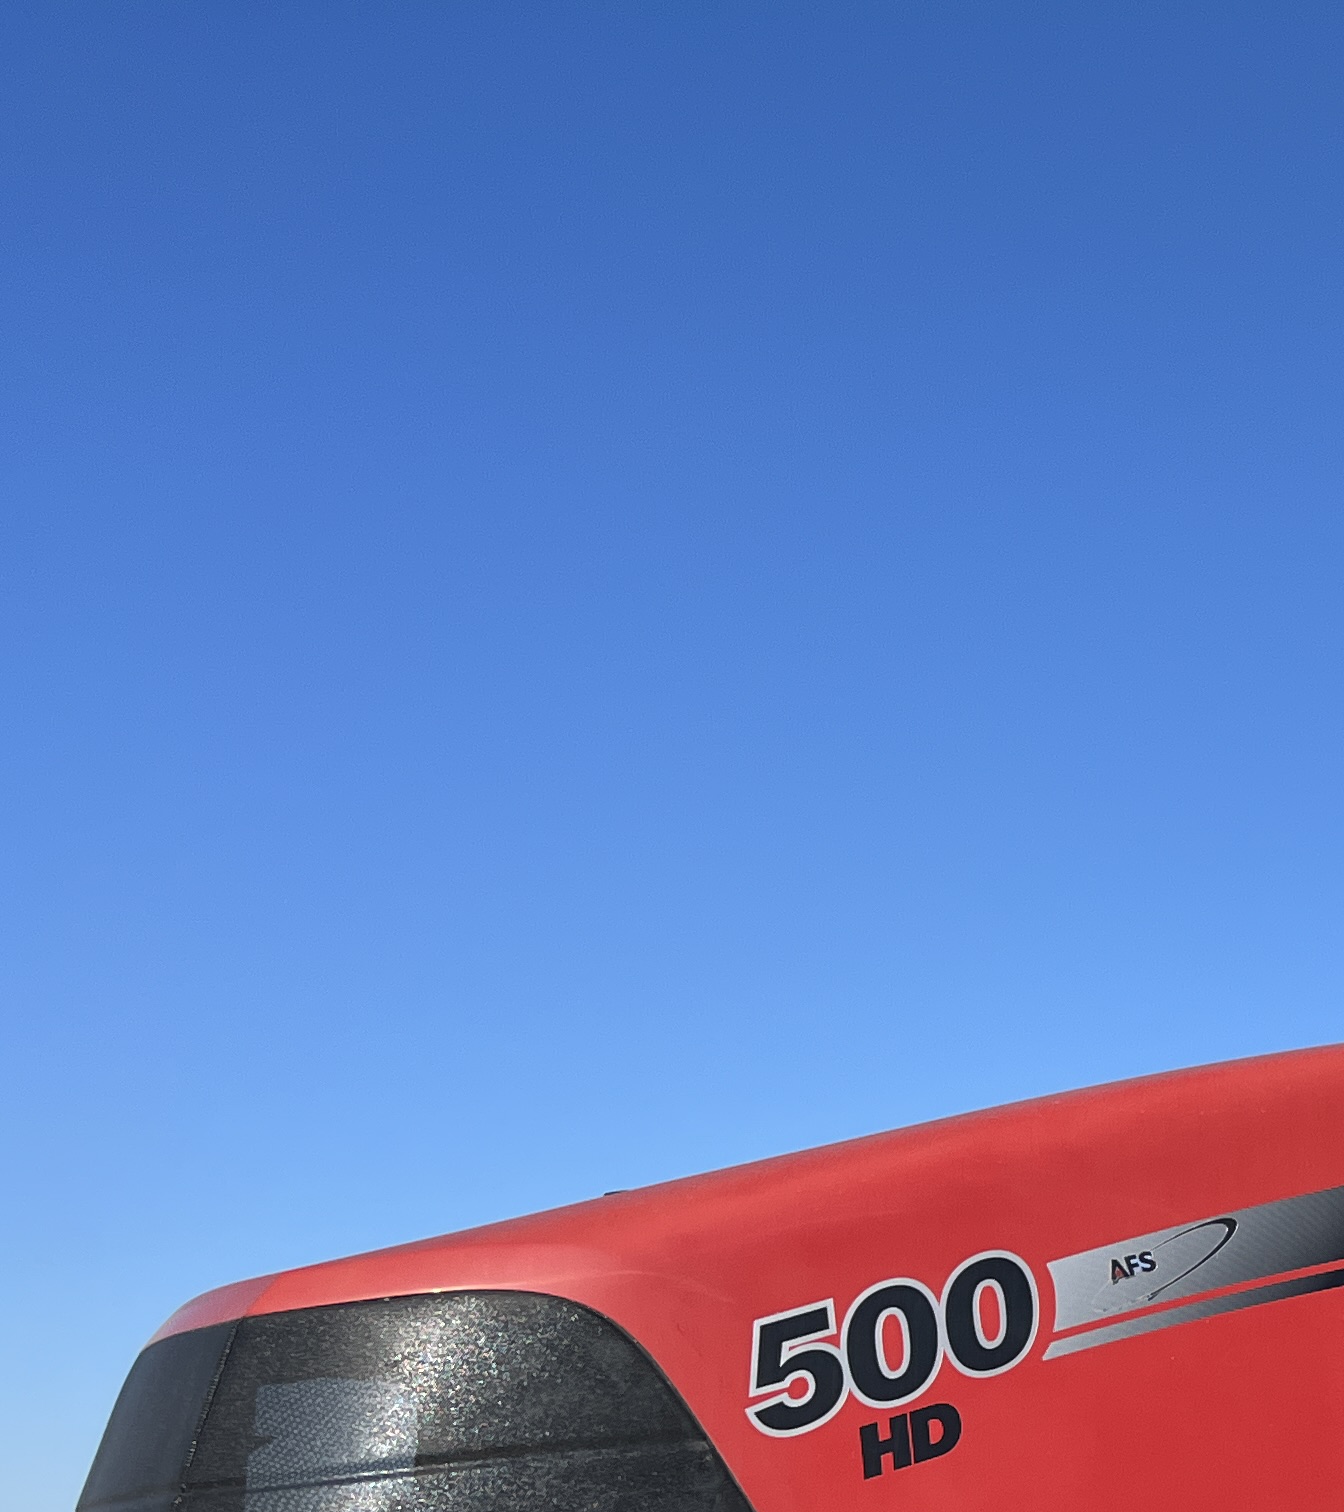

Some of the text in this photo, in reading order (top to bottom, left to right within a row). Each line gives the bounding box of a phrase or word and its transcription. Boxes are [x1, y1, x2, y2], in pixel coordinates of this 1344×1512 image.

[1110, 1250, 1158, 1285] AFS
[744, 1249, 1040, 1438] 500
[858, 1402, 963, 1481] HD
